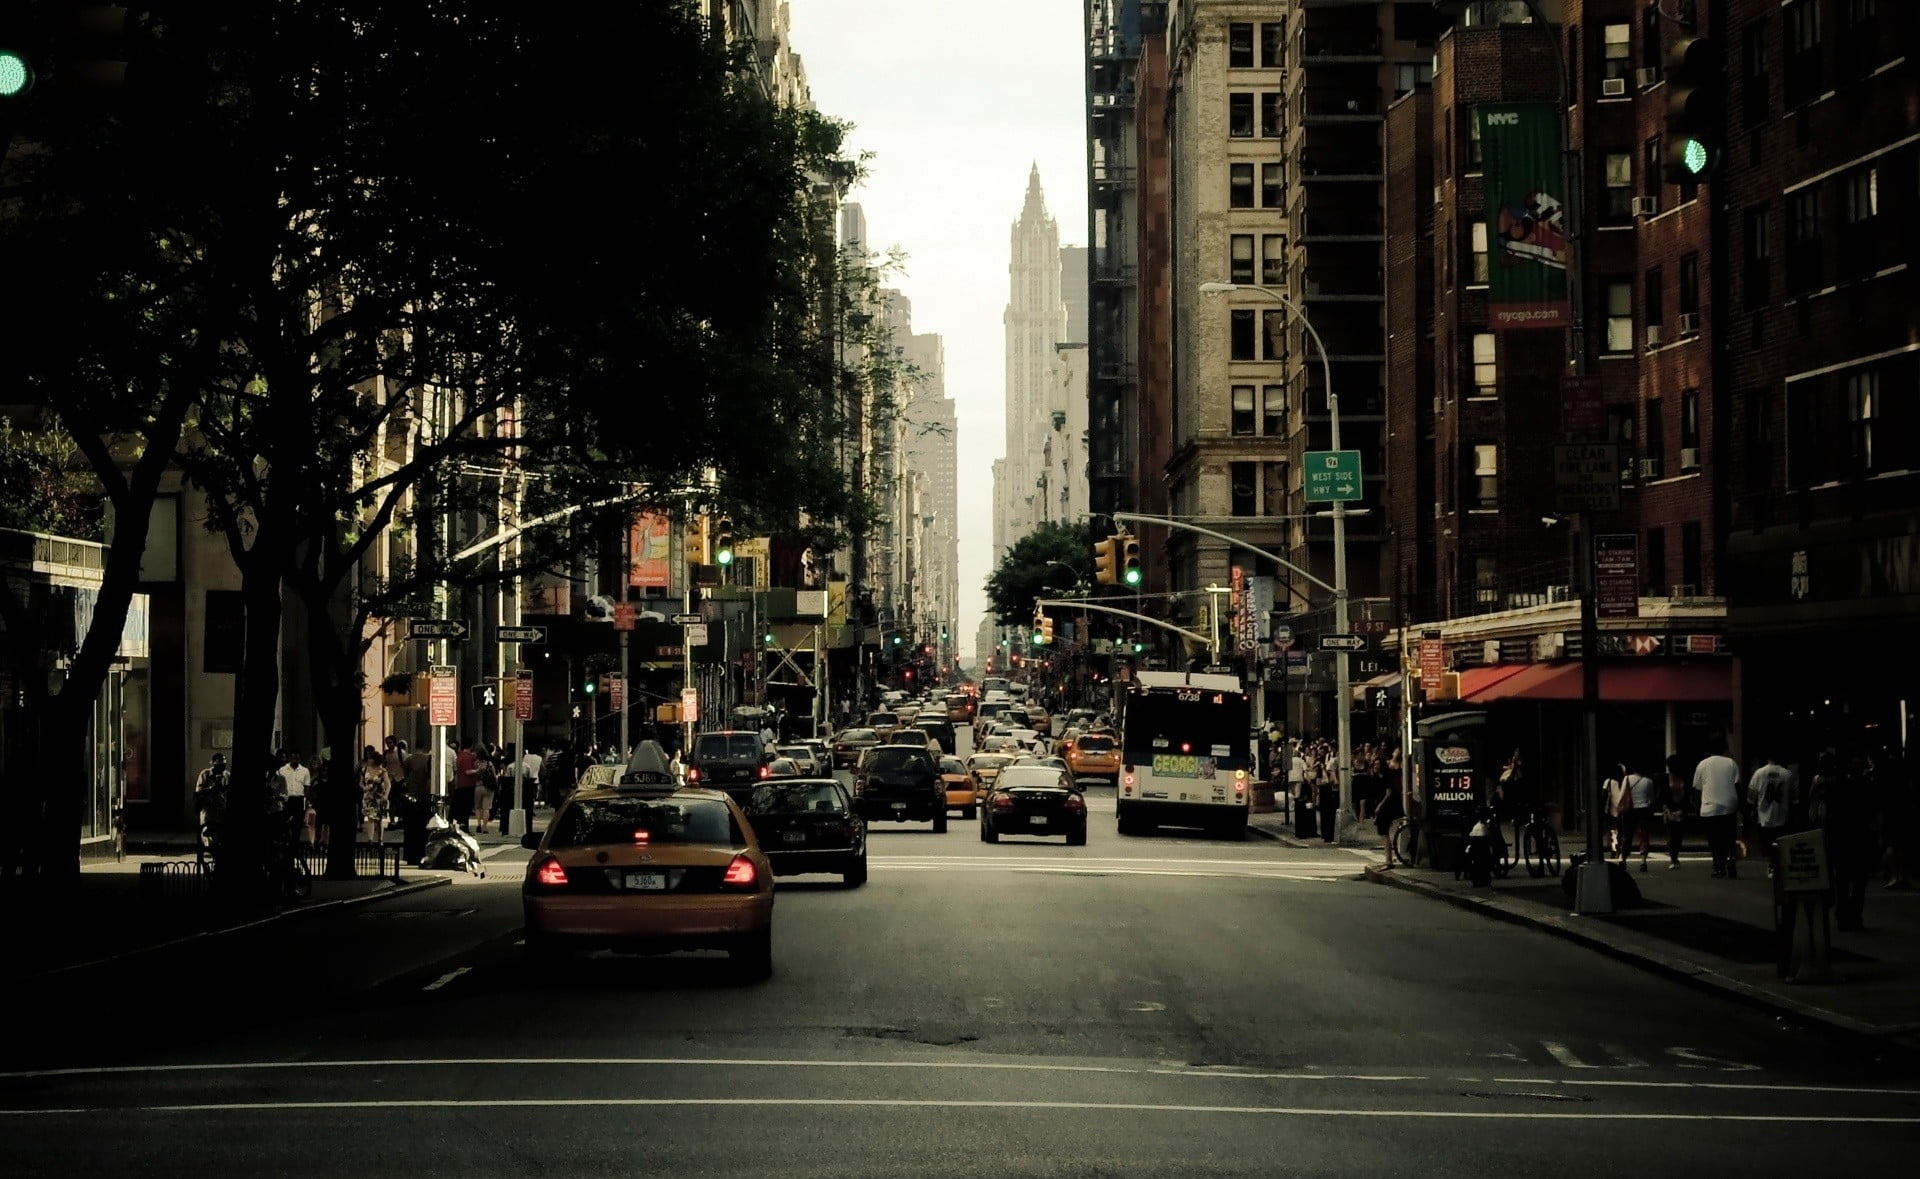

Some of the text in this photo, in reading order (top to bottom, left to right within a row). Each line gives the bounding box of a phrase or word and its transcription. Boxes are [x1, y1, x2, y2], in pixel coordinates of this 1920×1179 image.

[1488, 112, 1519, 126] NYC
[1498, 308, 1559, 323] nycgo.com
[1312, 472, 1353, 481] WEST SIDE
[1313, 486, 1331, 494] HWY
[418, 623, 435, 633] ONE
[1178, 693, 1201, 702] 6738
[1450, 776, 1471, 789] 113
[1434, 792, 1474, 801] MILLION
